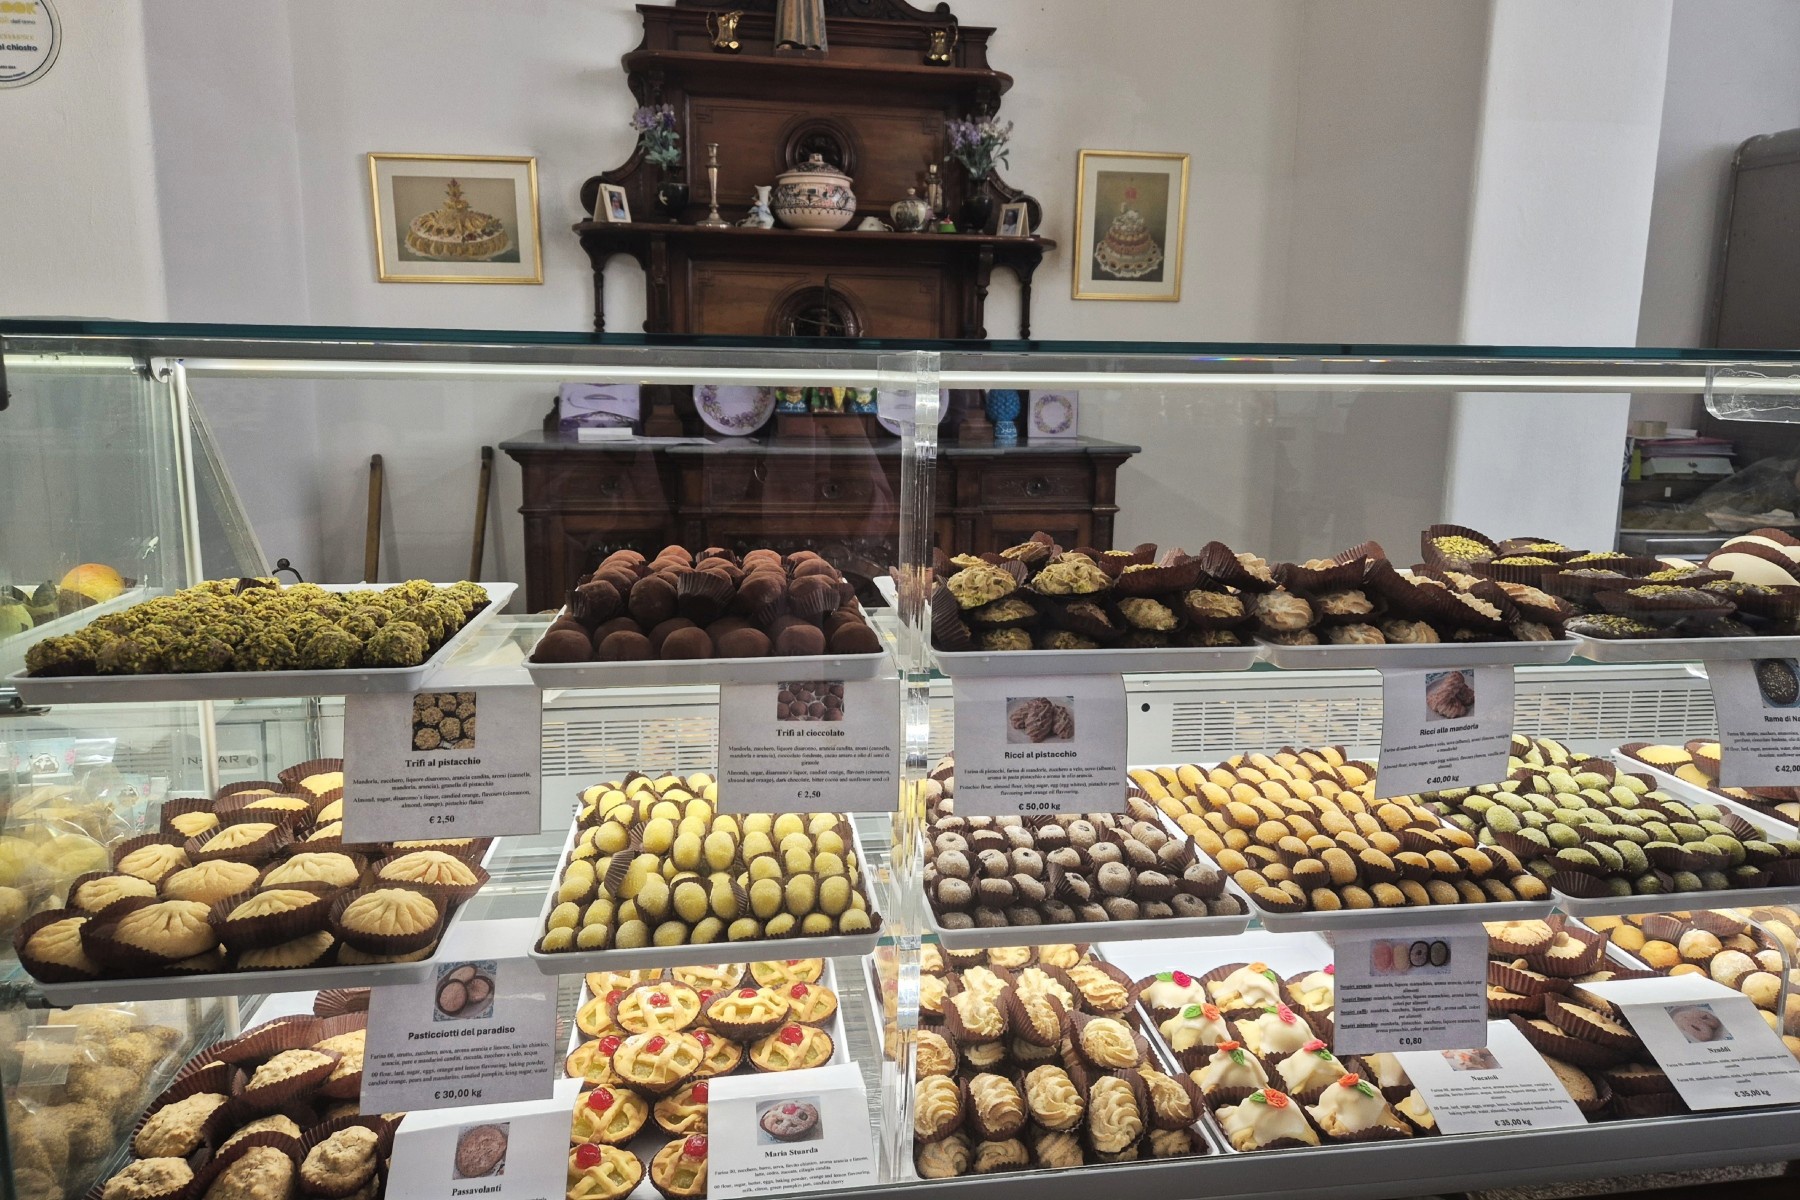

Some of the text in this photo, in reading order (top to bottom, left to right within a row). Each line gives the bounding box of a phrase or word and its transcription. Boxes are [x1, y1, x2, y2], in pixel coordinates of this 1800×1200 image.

[6, 44, 38, 52] chiostro
[797, 729, 804, 737] al
[806, 729, 845, 737] cioccolato
[1420, 728, 1436, 736] Ricci
[1449, 723, 1479, 732] mandorla
[1004, 751, 1024, 759] Ricci
[1035, 750, 1077, 760] pistacchio
[427, 759, 436, 767] al
[438, 757, 481, 768] pistacchio
[1426, 777, 1432, 785] €
[1432, 775, 1451, 784] 40,00
[804, 790, 821, 799] 2,50
[1018, 802, 1061, 811] € 50,00 kg
[429, 815, 455, 824] € 2,50
[408, 1026, 515, 1040] Pasticciotti del paradiso
[1405, 1037, 1422, 1046] 0,80
[434, 1089, 482, 1100] € 30,00 kg
[1740, 1089, 1761, 1097] 35,00
[1760, 1089, 1771, 1097] kg
[1500, 1118, 1522, 1126] 35,00
[765, 1147, 818, 1158] Maria Stuarda
[452, 1184, 502, 1196] Passavolanti
